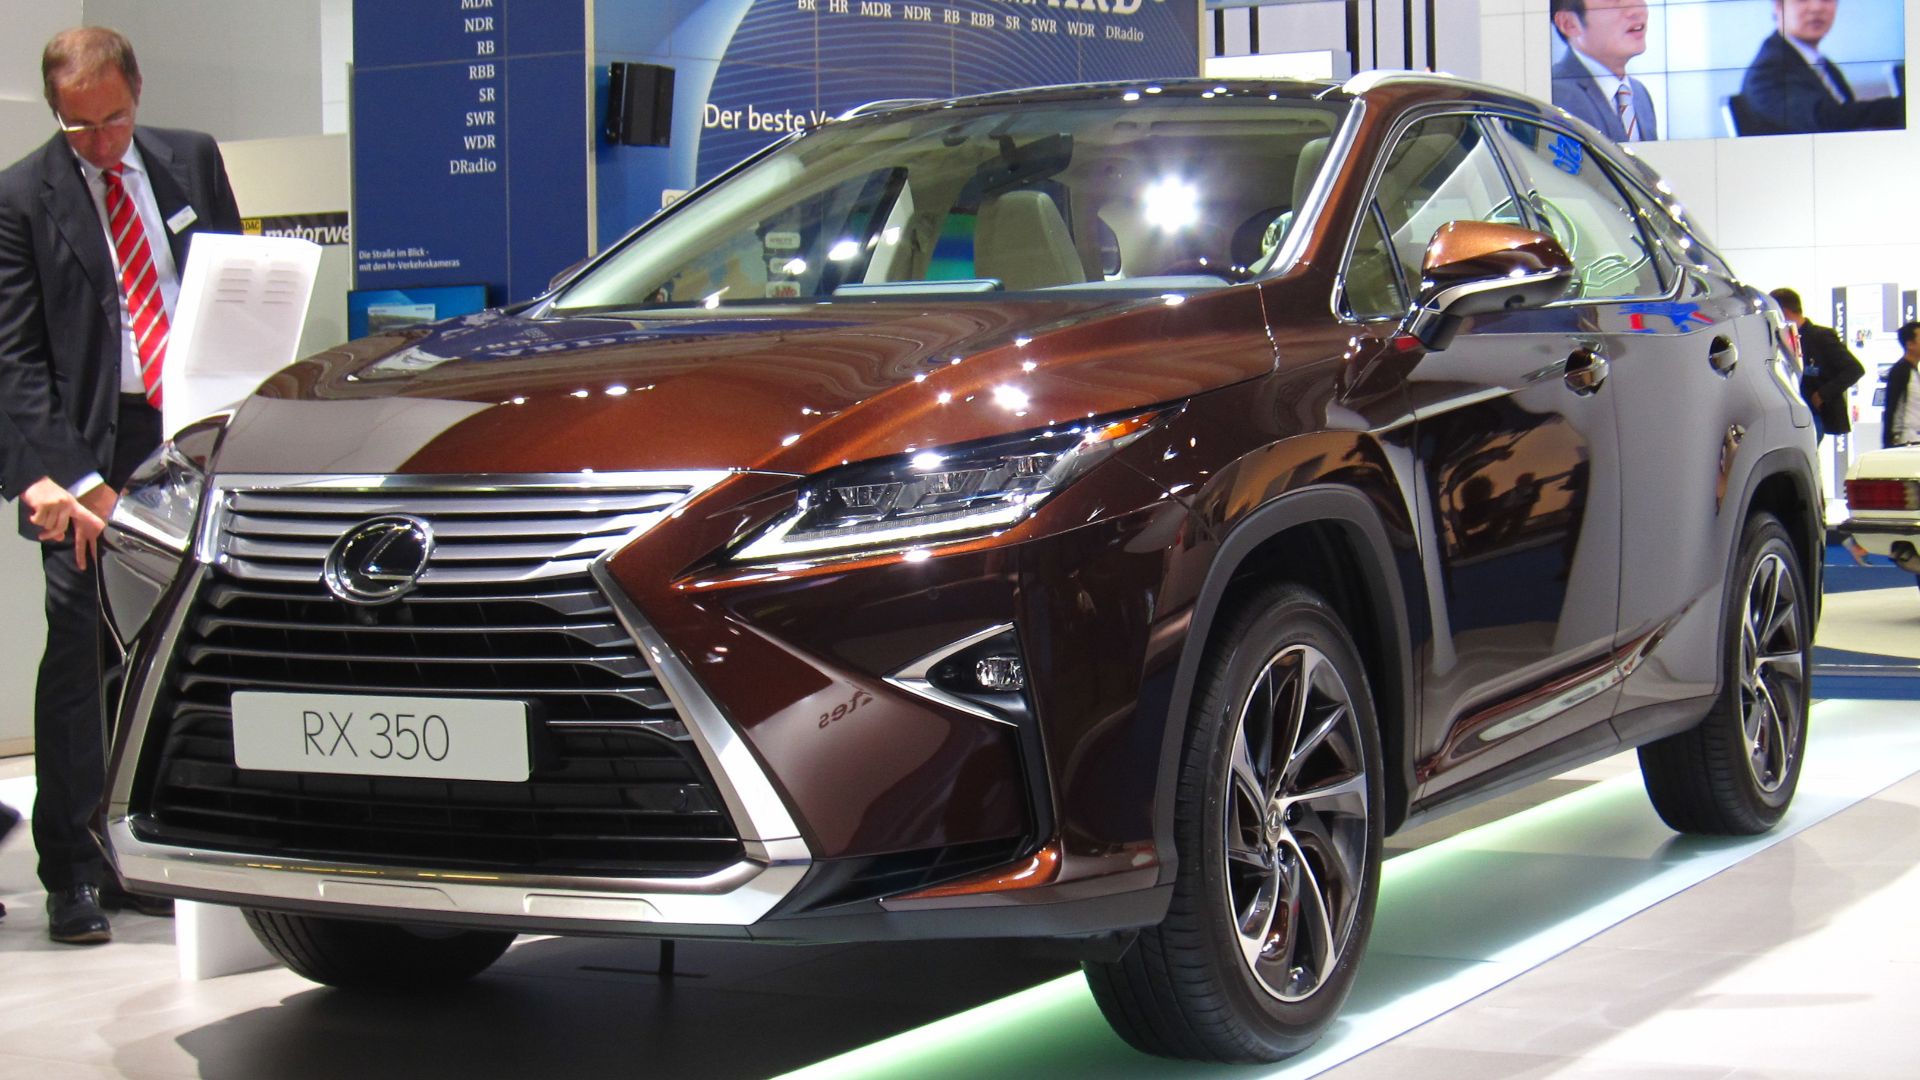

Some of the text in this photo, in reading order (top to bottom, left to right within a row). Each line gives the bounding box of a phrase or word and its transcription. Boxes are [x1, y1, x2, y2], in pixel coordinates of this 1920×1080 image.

[461, 0, 493, 9] MDR
[464, 17, 494, 33] NDR
[798, 0, 1144, 41] BR HR MDR NDR RB RBB SR SWR WDR DRadio
[477, 40, 495, 55] RB
[469, 64, 495, 80] RBB
[479, 88, 495, 102] SR
[466, 111, 495, 126] SWR
[704, 103, 835, 132] Der beste V
[464, 135, 496, 150] WDR
[450, 157, 497, 174] DRadio
[359, 249, 371, 260] Die
[372, 248, 396, 259] Straße
[396, 248, 407, 258] im
[408, 247, 425, 258] Blick
[359, 262, 371, 271] mit
[372, 261, 387, 271] den
[303, 710, 450, 761] RX 350
